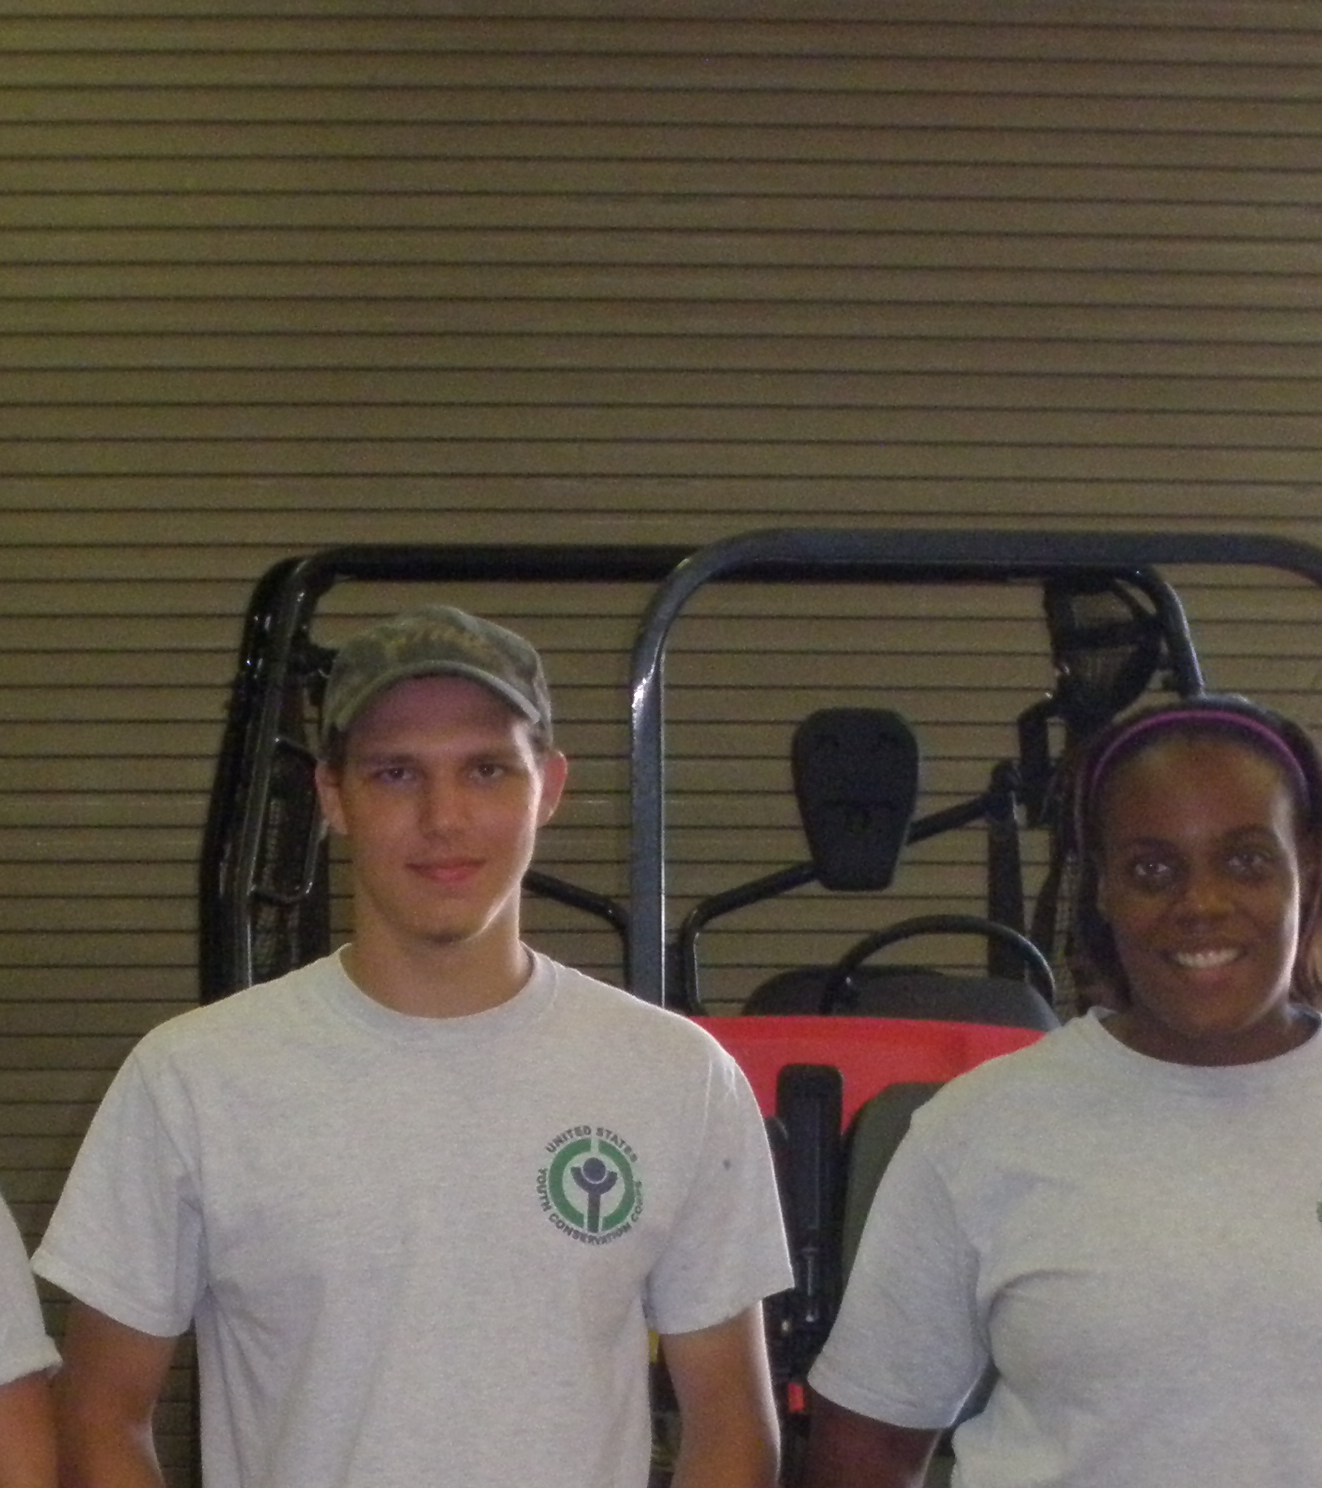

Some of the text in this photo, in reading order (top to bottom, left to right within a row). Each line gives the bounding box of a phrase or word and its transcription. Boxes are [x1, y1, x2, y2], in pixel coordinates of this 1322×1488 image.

[545, 1125, 638, 1163] UNITED STATES
[536, 1167, 552, 1212] YOUTH
[548, 1213, 632, 1246] CONSERVATION
